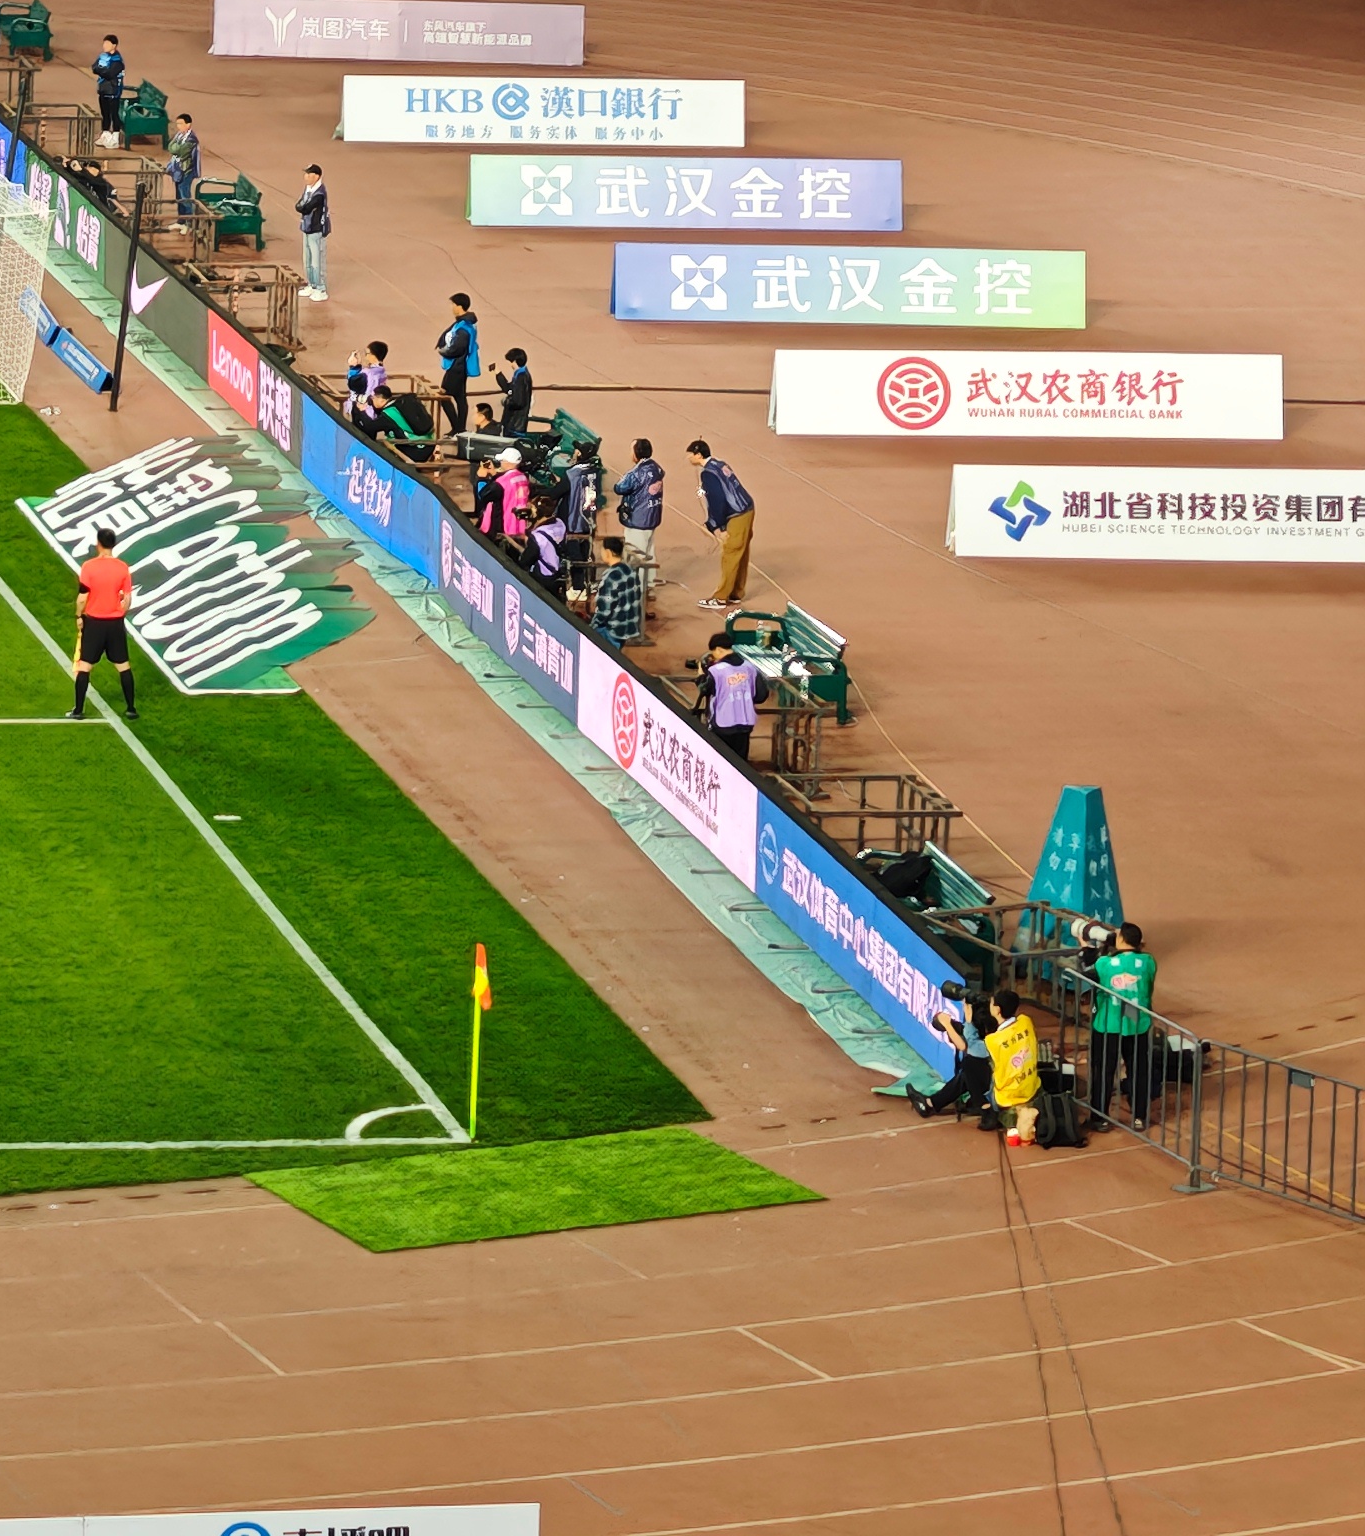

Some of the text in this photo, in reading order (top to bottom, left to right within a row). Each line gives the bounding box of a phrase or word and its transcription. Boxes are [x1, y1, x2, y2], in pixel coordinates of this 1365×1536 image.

[299, 17, 390, 41] 岚图汽车
[405, 86, 683, 120] HKB 漢口銀行
[424, 124, 664, 141] 服务地方 服务实体 服务中小
[594, 164, 853, 221] 武汉金控
[752, 254, 1034, 315] 武汉金控
[211, 329, 254, 404] Lenovo
[966, 368, 1184, 407] 武汉农商银行
[967, 407, 1184, 420] WUHAN RURAL COMMERCIAL BANK
[1062, 490, 1365, 523] 湖北省科技投资集团有
[1062, 524, 1103, 535] HUBEI
[1107, 524, 1166, 536] SCIENCE
[1171, 524, 1261, 537] TECHNOLOGY
[1266, 525, 1350, 538] INVESTMENT
[641, 708, 721, 817] 武汉农商银行
